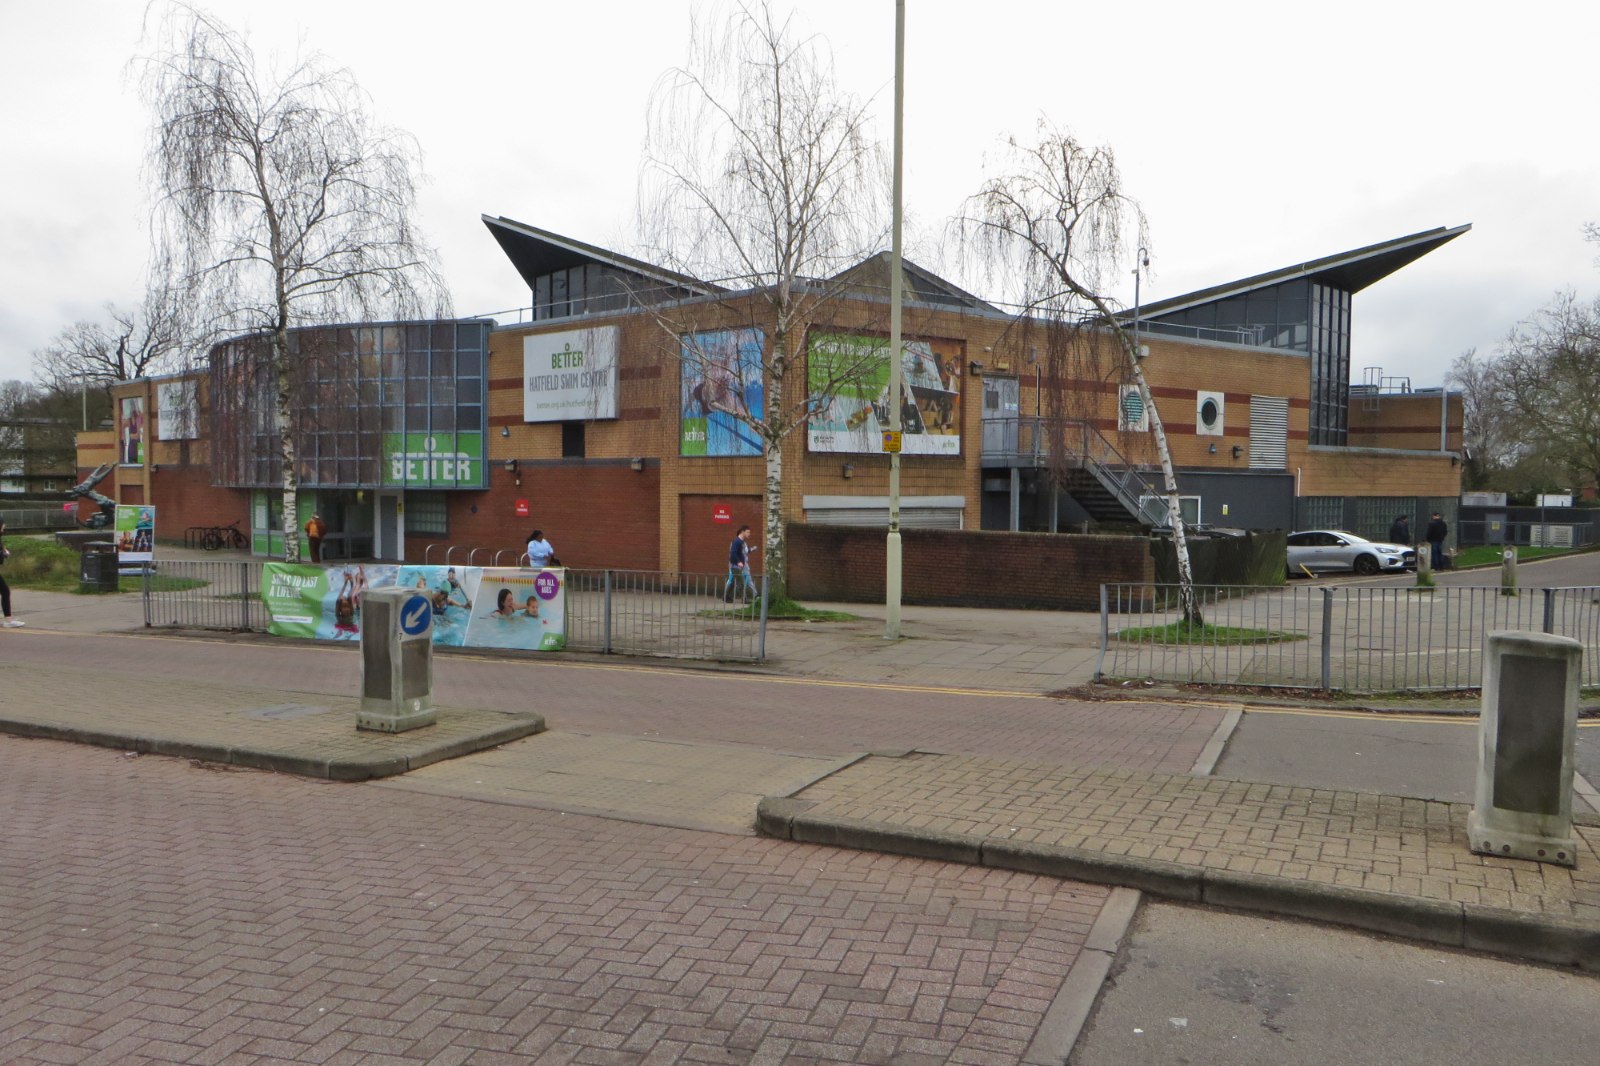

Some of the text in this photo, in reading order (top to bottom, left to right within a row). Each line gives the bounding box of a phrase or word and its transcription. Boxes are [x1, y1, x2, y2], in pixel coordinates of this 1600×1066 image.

[552, 351, 583, 369] BETTER
[530, 370, 607, 392] HATFIELD SWIM CENTRE
[392, 453, 470, 480] BETTER
[292, 576, 302, 587] TO
[302, 577, 318, 588] LAST
[537, 578, 555, 587] FOR ALL
[269, 585, 275, 597] A
[541, 586, 552, 594] AGES
